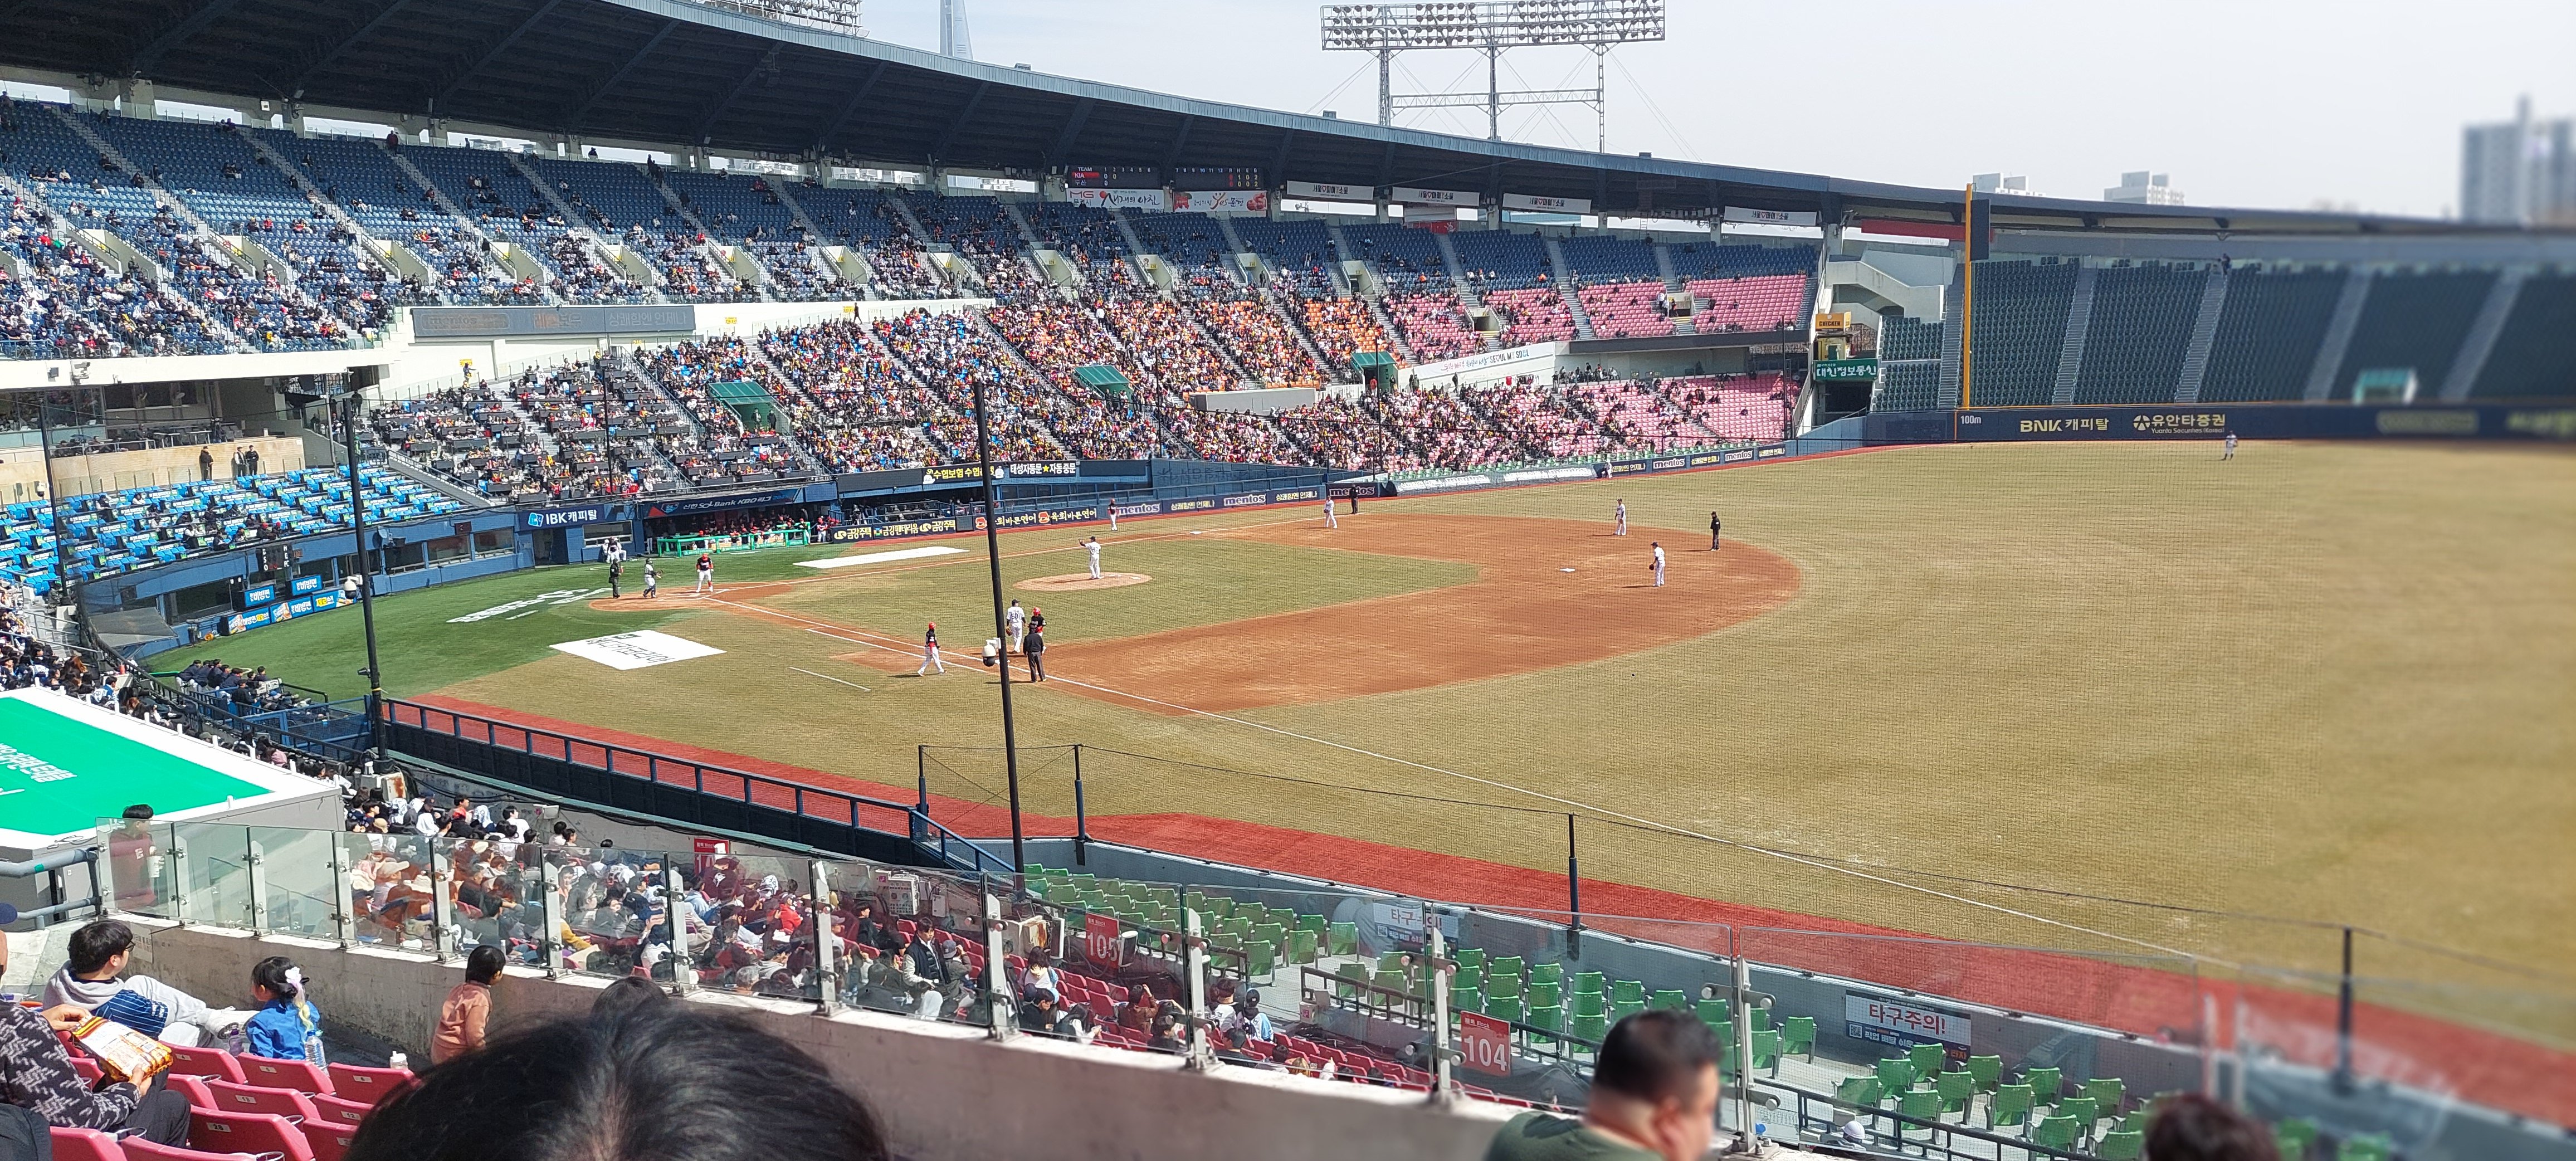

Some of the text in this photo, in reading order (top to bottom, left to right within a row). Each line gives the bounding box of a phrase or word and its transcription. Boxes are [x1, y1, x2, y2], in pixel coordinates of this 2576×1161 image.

[1817, 365, 1876, 377] 대신정보통신
[1960, 415, 1982, 425] 100m
[2020, 418, 2109, 432] BNK 캐피탈
[2151, 414, 2226, 427] 유안타증권
[1725, 451, 1753, 461] mentos
[1010, 462, 1076, 475] 태성자동문 자동중문
[1653, 458, 1685, 469] mentos
[933, 469, 964, 479] 수협보험
[1224, 494, 1266, 506] mentos
[546, 509, 597, 525] IBK캐피탈
[994, 513, 1036, 526] 회바른연어
[931, 520, 956, 532] 금강주택
[847, 526, 872, 540] 금강주택
[1391, 909, 1442, 930] 타구의!
[1087, 932, 1118, 962] 105
[1477, 1020, 1490, 1028] Block
[1869, 1003, 1945, 1035] 타구주의!
[1881, 1035, 1896, 1045] 배달
[1464, 1035, 1507, 1071] 104
